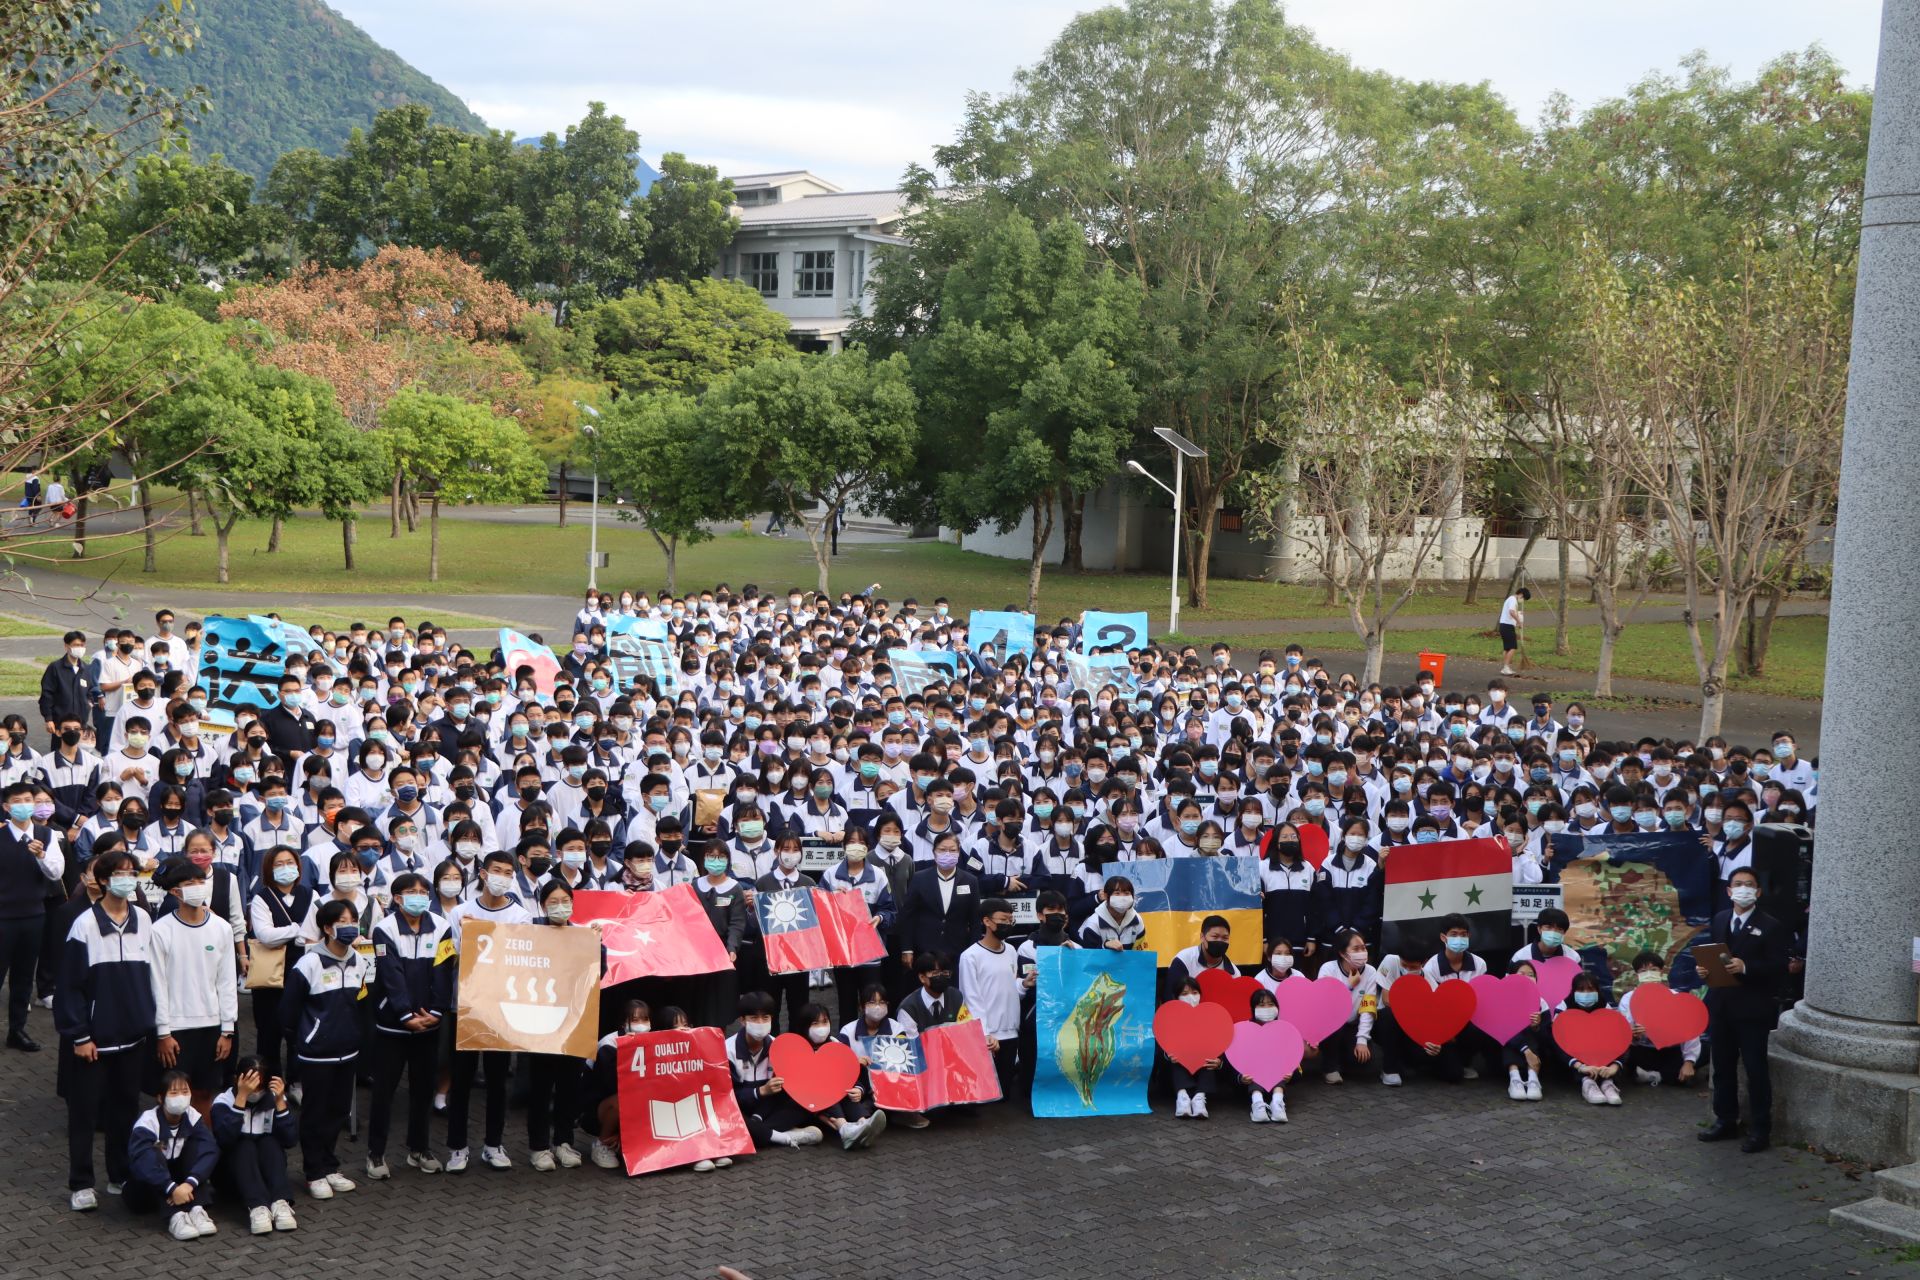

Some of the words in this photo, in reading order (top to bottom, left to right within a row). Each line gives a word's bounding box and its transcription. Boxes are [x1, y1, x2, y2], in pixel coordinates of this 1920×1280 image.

[199, 633, 281, 709] 送
[477, 934, 495, 965] 2
[505, 937, 533, 952] ZERO
[504, 954, 551, 969] HUNGER
[654, 1041, 691, 1057] QUALITY
[630, 1046, 647, 1078] 4
[655, 1059, 704, 1076] EDUCATION
